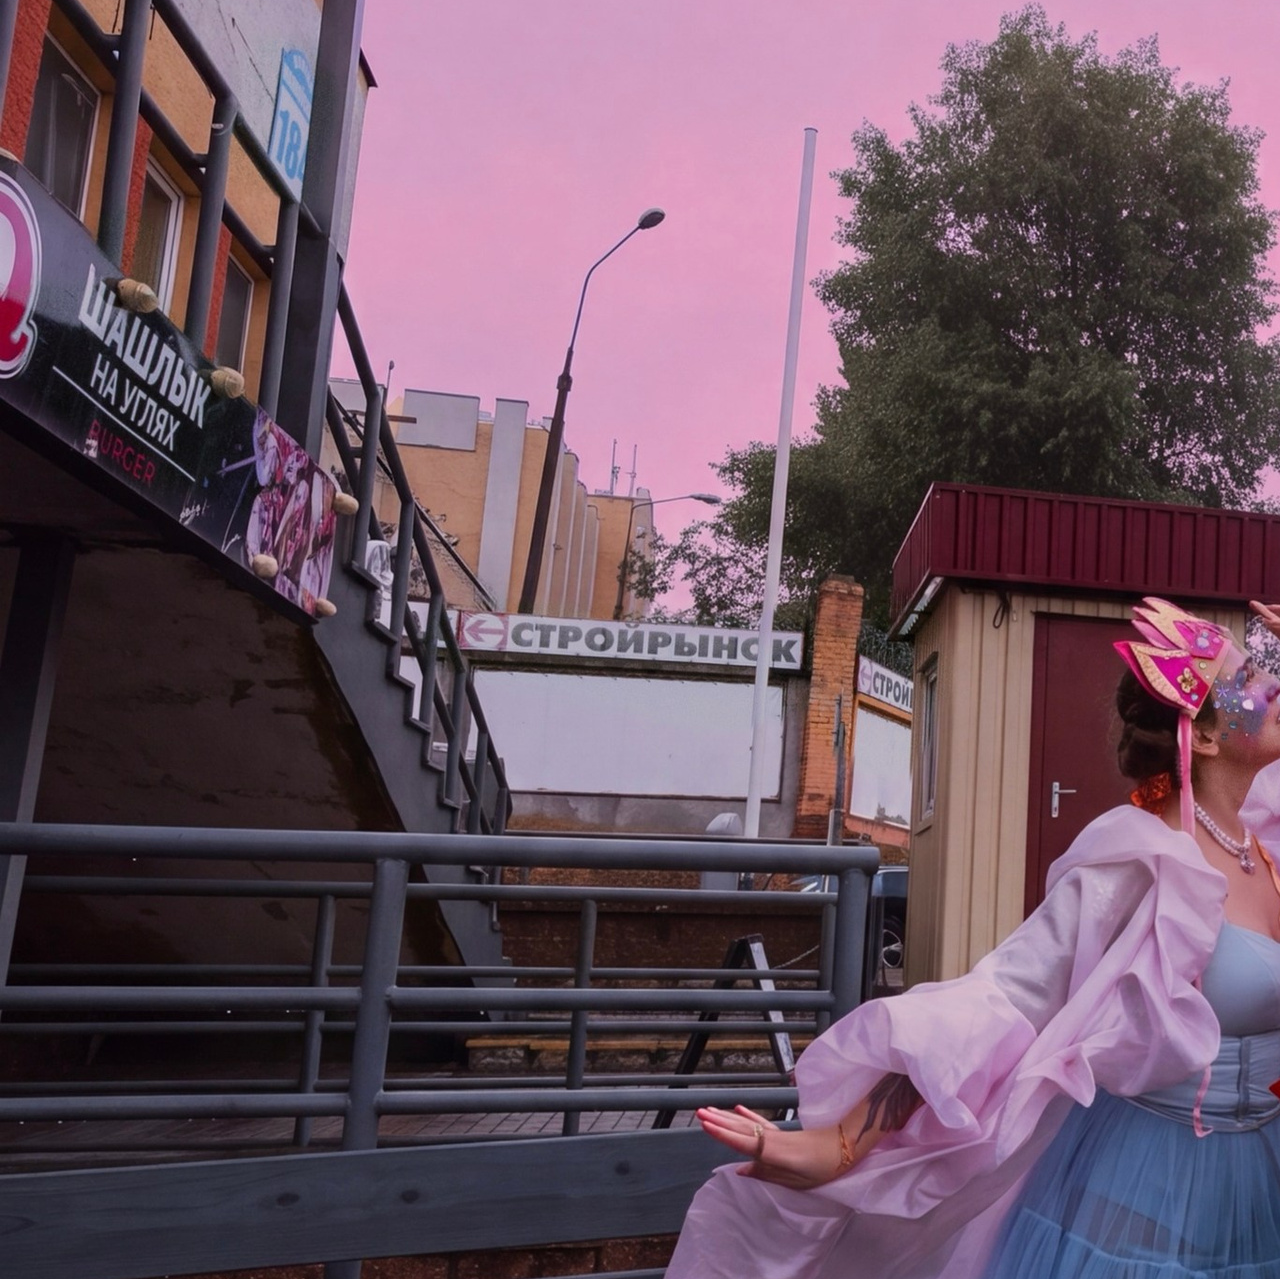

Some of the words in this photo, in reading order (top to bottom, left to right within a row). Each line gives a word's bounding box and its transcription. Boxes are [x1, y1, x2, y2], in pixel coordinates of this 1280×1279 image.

[276, 109, 306, 181] 18
[79, 263, 211, 429] ШАШЛЫК
[90, 353, 116, 406] НА
[119, 378, 181, 452] УГЛЯХ
[510, 622, 801, 664] СТРОЙРЫНОК
[872, 670, 914, 709] СТРОЙ
